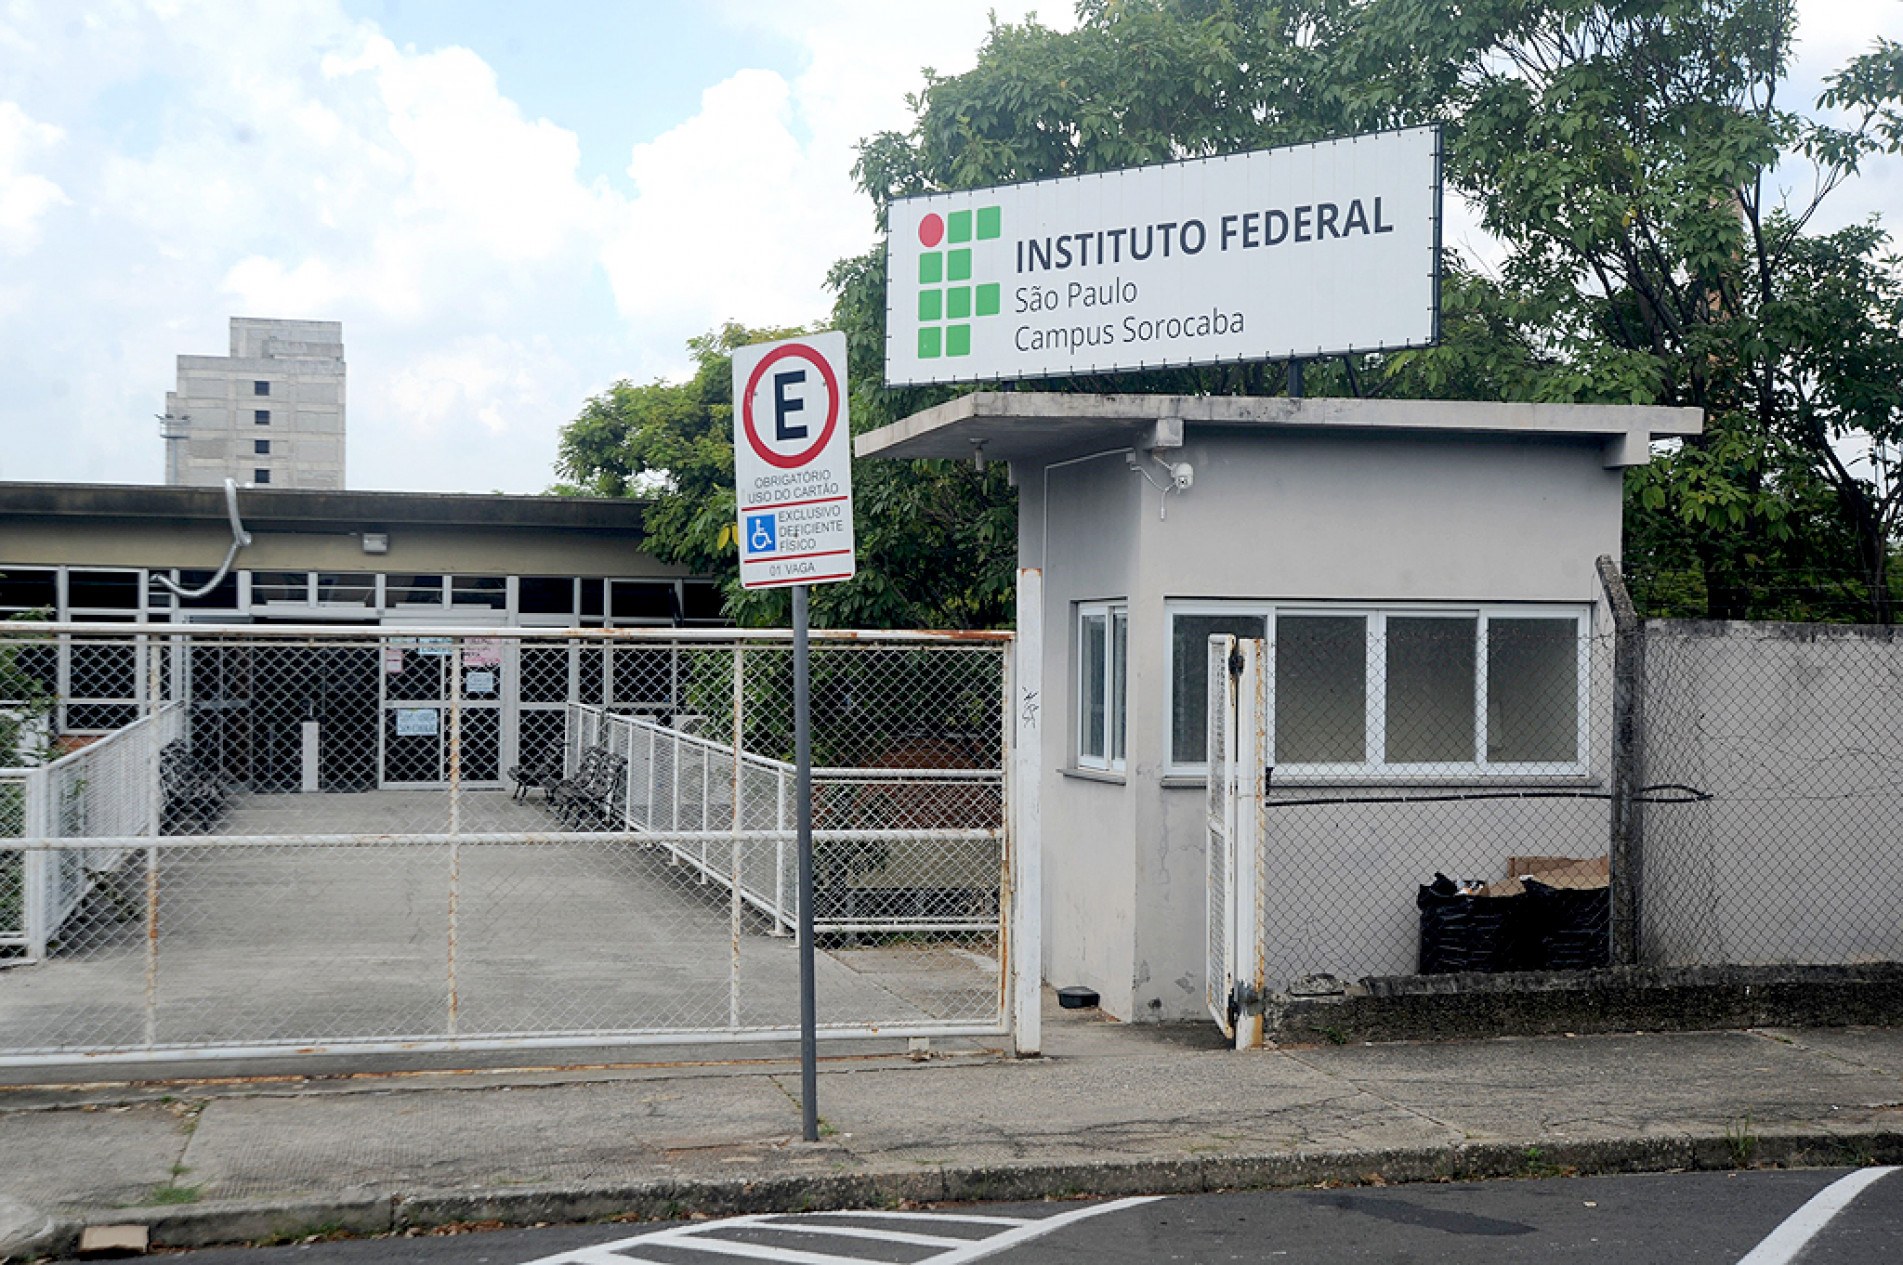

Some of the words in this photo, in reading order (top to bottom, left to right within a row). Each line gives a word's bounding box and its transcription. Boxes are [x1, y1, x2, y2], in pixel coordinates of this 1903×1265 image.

[1017, 219, 1207, 273] INSTITUTO
[1221, 196, 1394, 251] FEDERAL
[1015, 285, 1058, 313] São
[1068, 277, 1138, 308] Paulo
[1015, 325, 1114, 355] Campus
[1122, 307, 1244, 343] Sorocaba
[774, 369, 808, 441] E
[748, 491, 772, 504] USO
[775, 488, 791, 500] DO
[793, 483, 839, 498] CARTÃO
[779, 505, 841, 522] EXCLUSIVO
[779, 520, 844, 538] DEFICIENTE
[769, 565, 781, 577] 01
[785, 562, 816, 574] VAGA
